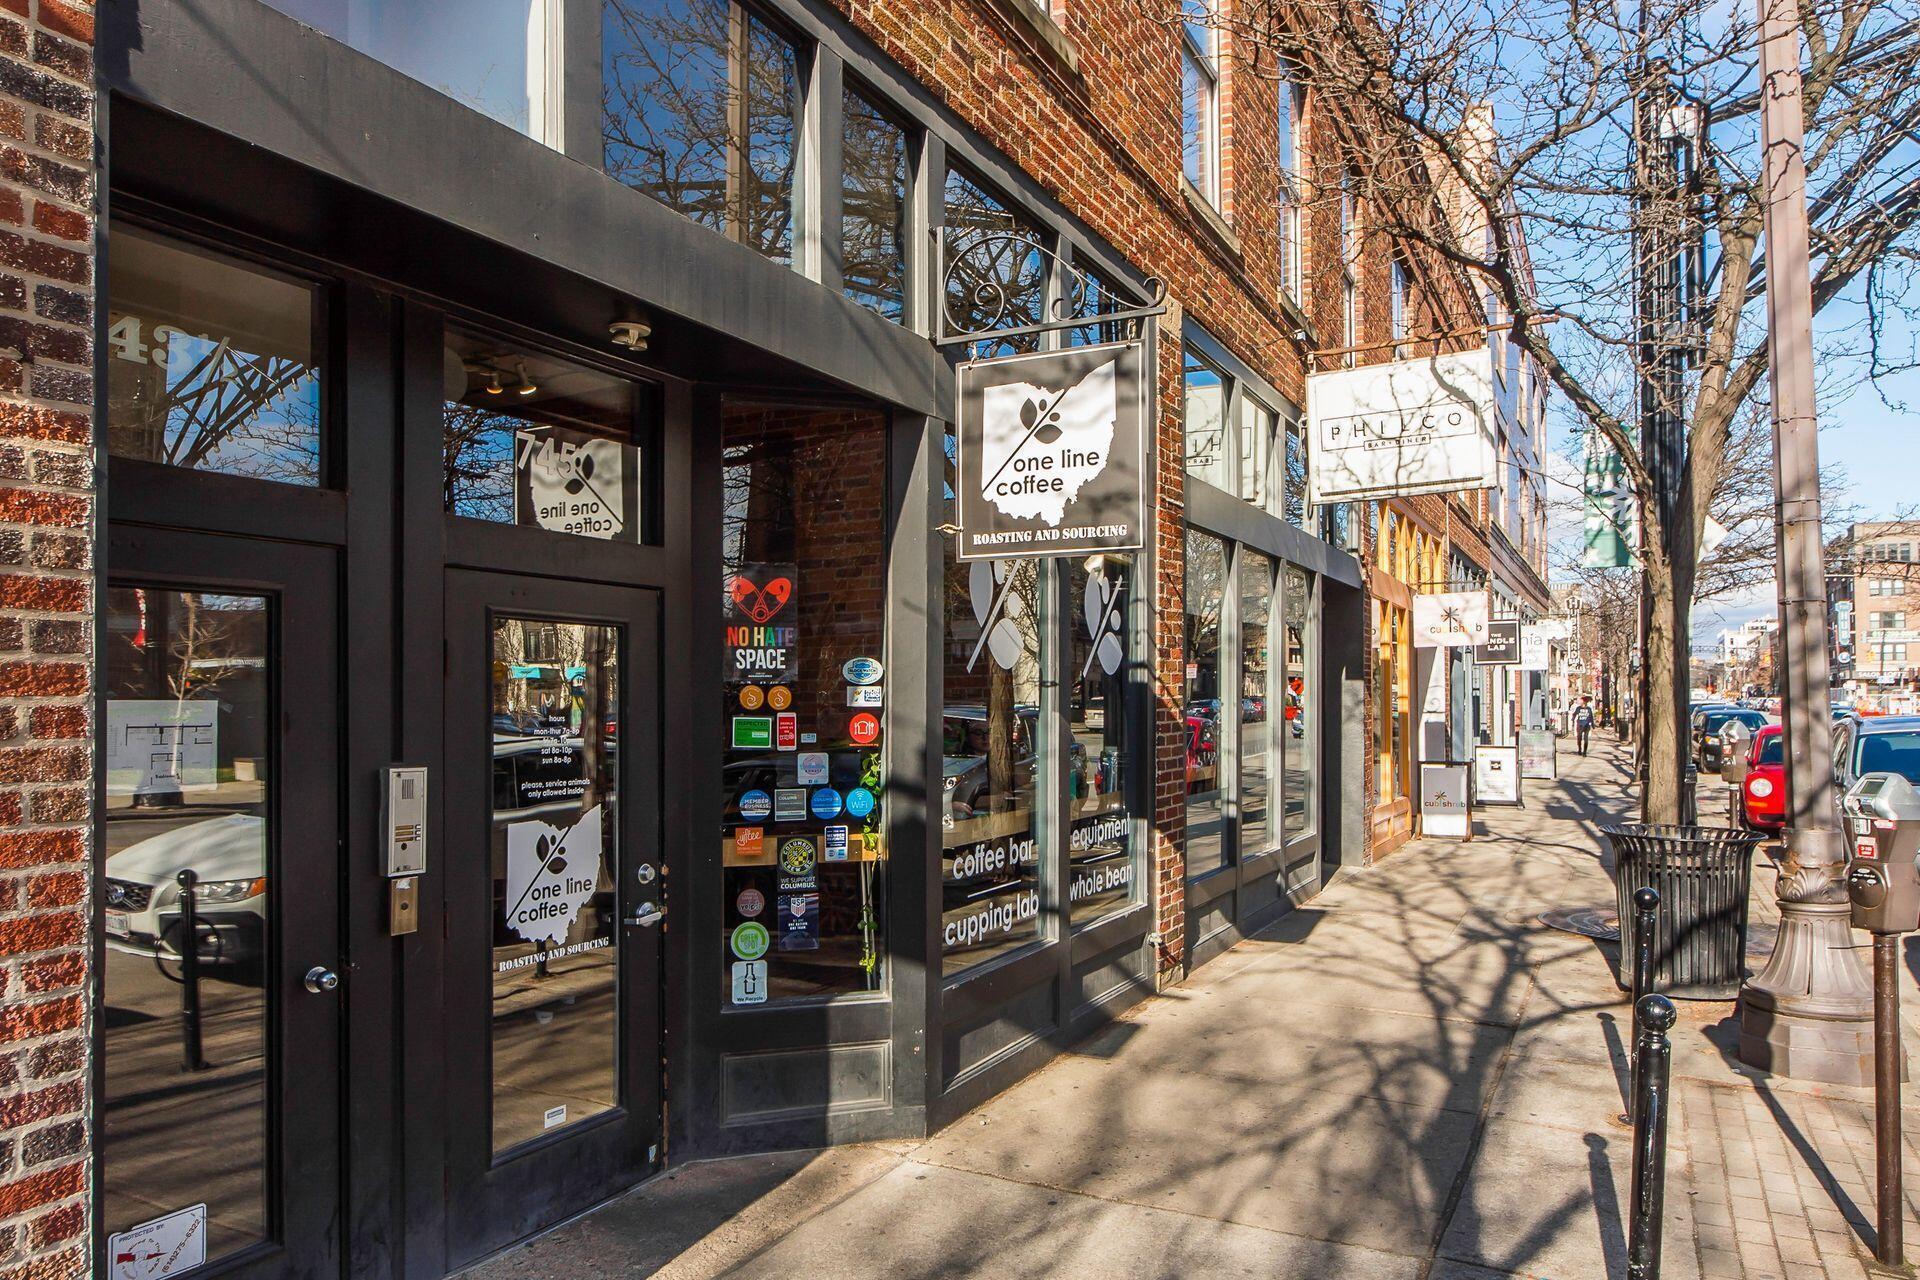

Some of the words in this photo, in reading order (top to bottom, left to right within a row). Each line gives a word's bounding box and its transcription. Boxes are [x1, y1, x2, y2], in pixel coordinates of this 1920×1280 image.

[1013, 454, 1054, 472] one
[1060, 448, 1100, 468] line
[996, 474, 1064, 496] coffee
[972, 529, 1032, 546] ROASTING
[1034, 527, 1060, 542] AND
[1062, 524, 1128, 539] SOURCING
[727, 626, 749, 647] NO
[753, 626, 794, 647] HATE
[1488, 637, 1515, 645] NDLE
[735, 648, 786, 670] SPACE
[548, 714, 566, 722] hours
[551, 746, 573, 755] 8a-10p
[553, 756, 572, 765] 8a-8p
[527, 790, 542, 799] only
[542, 788, 566, 797] allowed
[567, 787, 585, 795] inside
[545, 779, 567, 788] service
[568, 778, 590, 787] animals
[1071, 811, 1131, 852] equipment
[783, 841, 813, 855] COLUMBUS
[952, 842, 1004, 880] coffee
[1009, 837, 1035, 865] bar
[531, 881, 561, 901] one
[566, 876, 593, 895] line
[1069, 870, 1103, 901] whole
[1105, 863, 1133, 890] bean
[517, 899, 569, 924] coffee
[944, 901, 1013, 946] cupping
[1016, 889, 1040, 920] lab
[499, 952, 546, 973] ROASTING
[547, 945, 566, 961] AND
[567, 936, 609, 956] SOURCING
[118, 1228, 155, 1243] PROTECTED
[156, 1223, 166, 1231] BY
